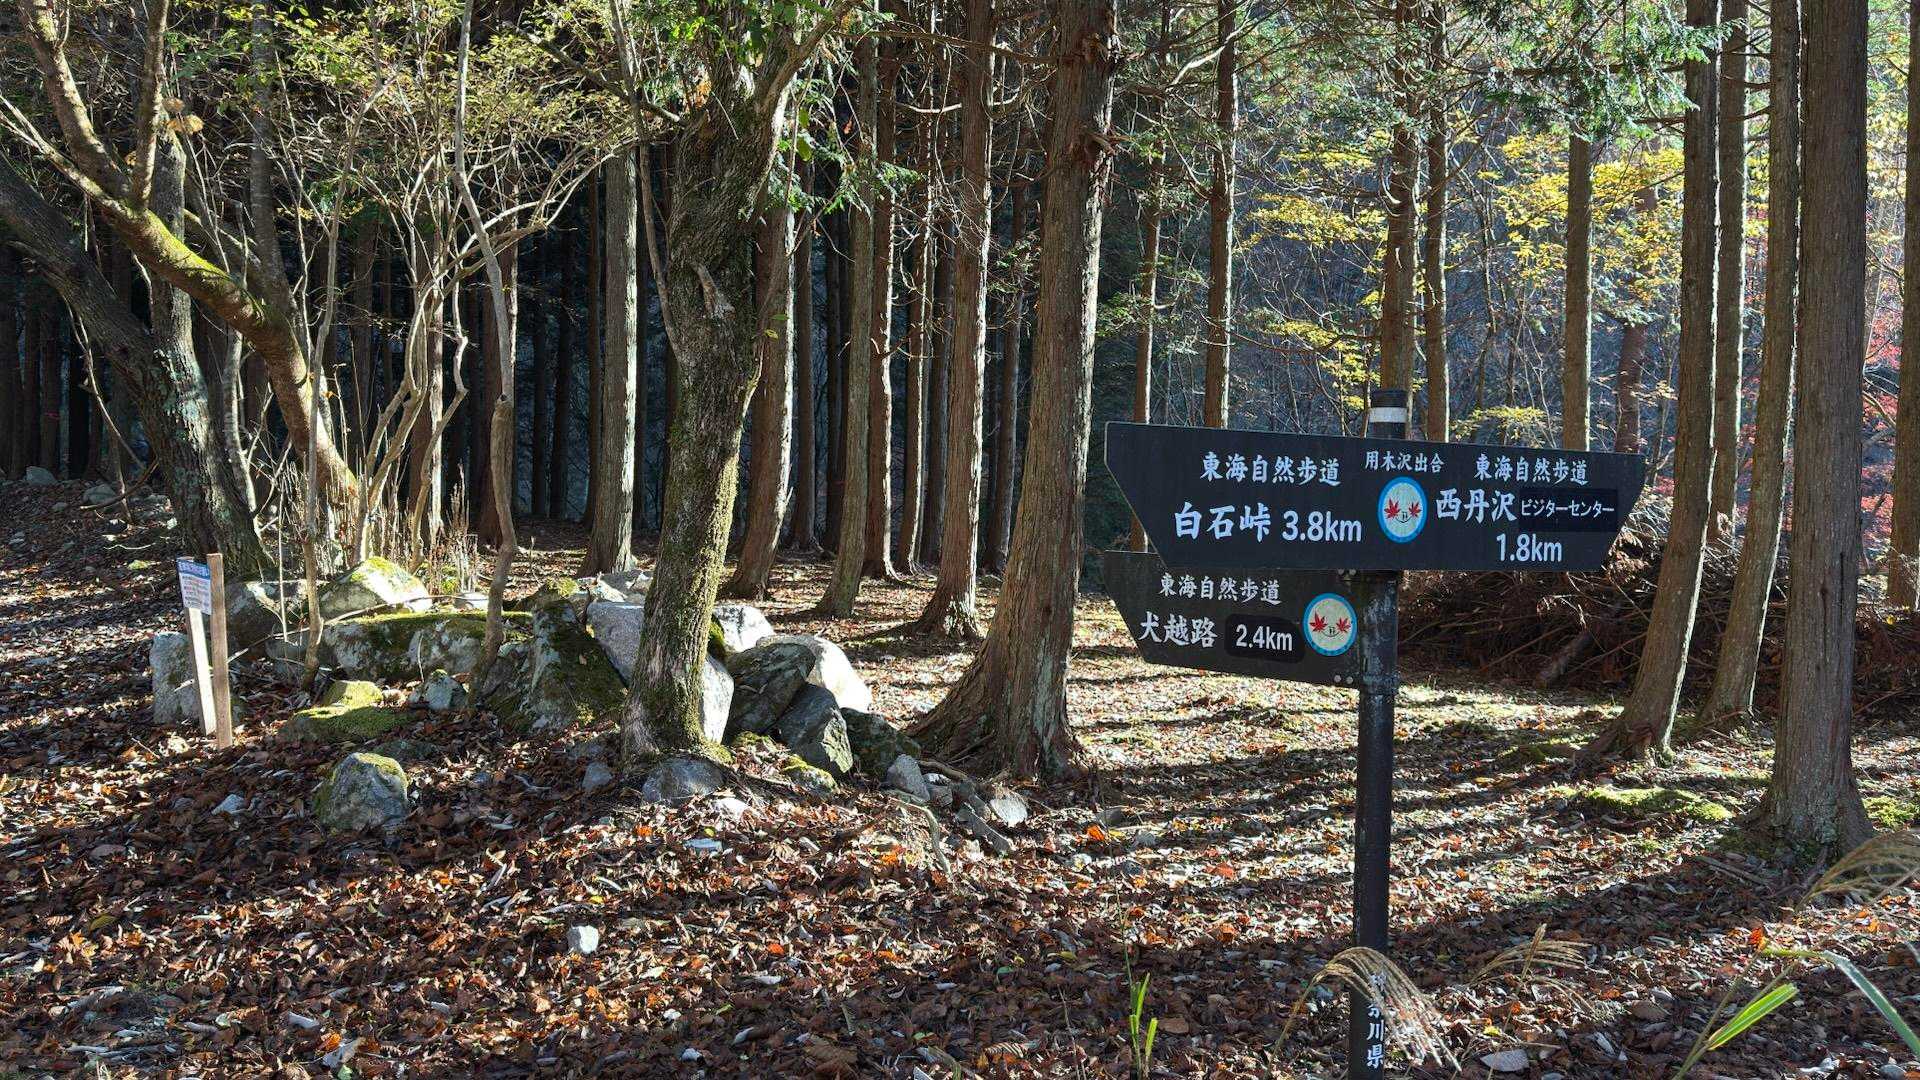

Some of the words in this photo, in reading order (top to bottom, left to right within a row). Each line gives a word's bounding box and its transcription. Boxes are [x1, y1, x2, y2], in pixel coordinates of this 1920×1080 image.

[1200, 451, 1341, 487] 東海自然歩道
[1365, 450, 1445, 474] 用木沢出合
[1474, 453, 1589, 486] 東海自然歩道
[1174, 501, 1271, 543] 白石峠
[1282, 510, 1362, 543] 3.8km
[1436, 487, 1518, 524] 西丹沢
[1496, 532, 1563, 563] 1.8km
[1158, 572, 1282, 606] 東海自然歩道
[1138, 611, 1218, 648] 犬越路
[1235, 623, 1293, 652] 2.4km
